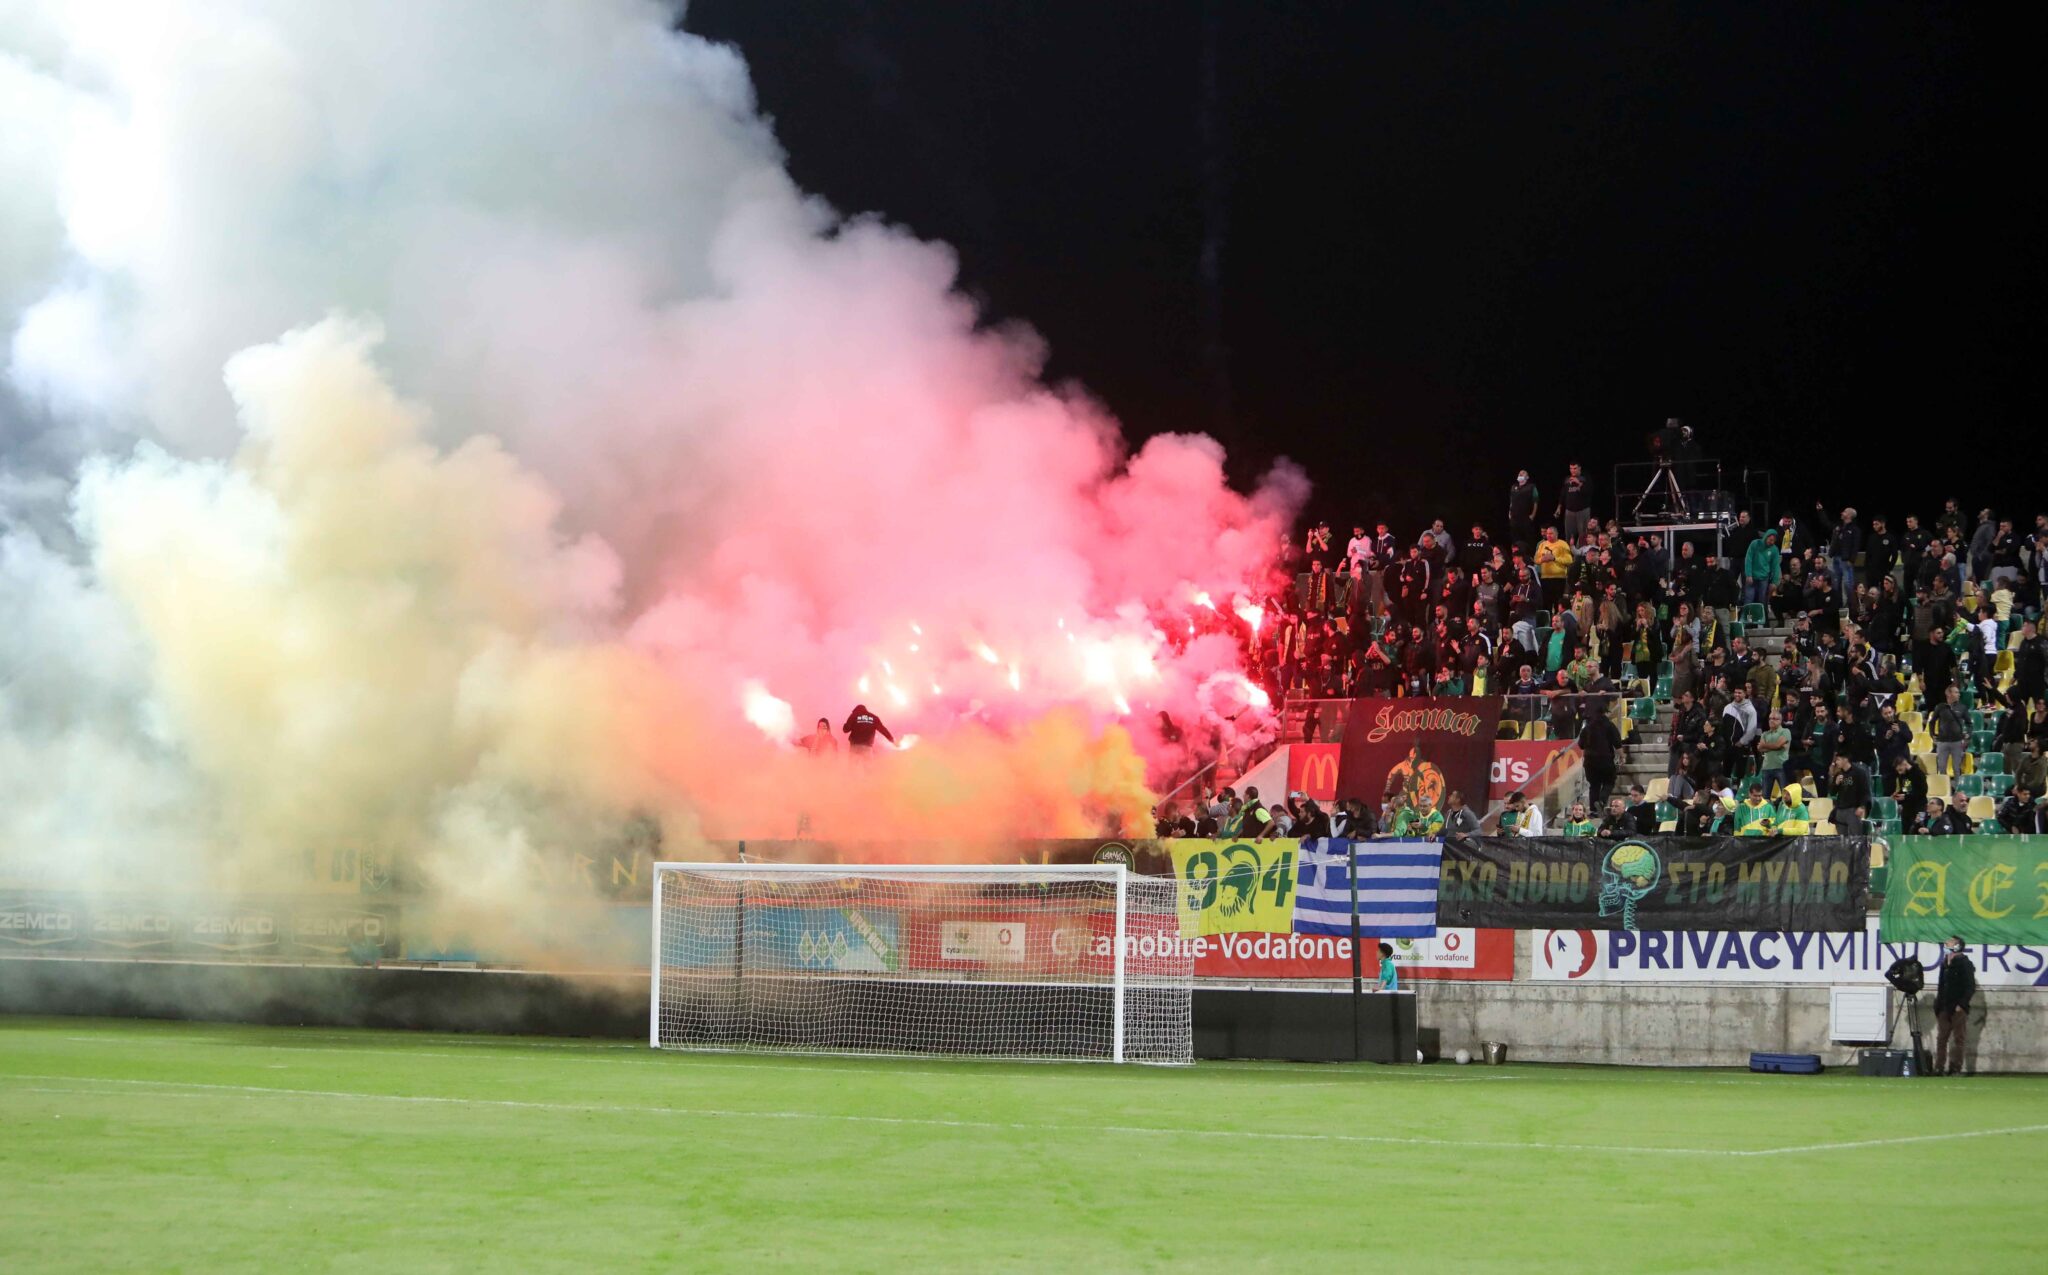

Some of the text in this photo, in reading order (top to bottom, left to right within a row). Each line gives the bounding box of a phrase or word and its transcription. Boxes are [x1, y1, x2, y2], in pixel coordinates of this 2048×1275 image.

[1367, 705, 1481, 743] Larnaca
[0, 912, 72, 930] ZEMCO
[93, 913, 170, 932] ZEMCO
[193, 916, 274, 934] ZEMCO
[1435, 953, 1469, 962] vodafone
